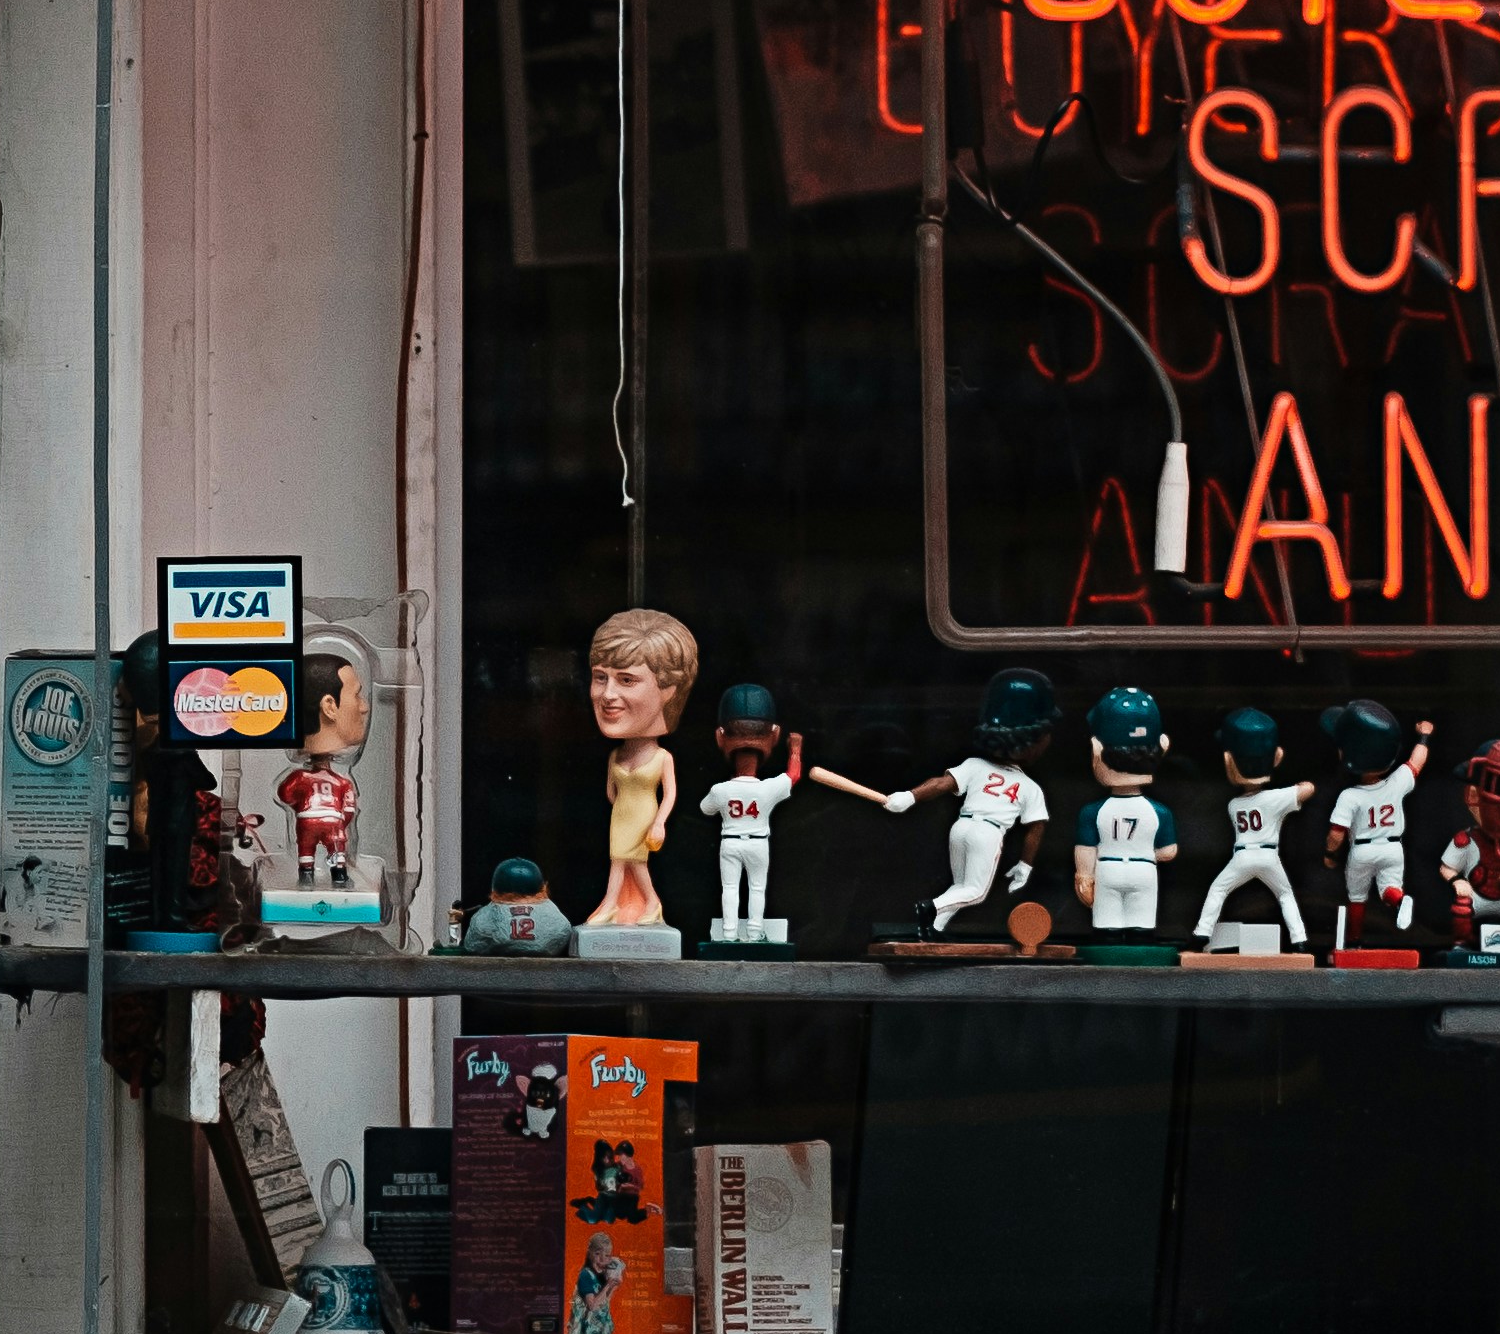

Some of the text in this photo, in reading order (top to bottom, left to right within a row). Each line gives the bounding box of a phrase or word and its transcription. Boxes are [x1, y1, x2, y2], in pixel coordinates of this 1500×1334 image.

[189, 591, 271, 618] VISA
[41, 685, 76, 716] JOE
[175, 691, 285, 714] MasterCard
[24, 708, 81, 744] LOUIS
[982, 772, 1021, 804] 24
[107, 793, 131, 851] JOE
[727, 799, 760, 819] 34
[1236, 810, 1263, 832] 50
[1367, 805, 1396, 829] 12
[1111, 817, 1138, 842] 17
[509, 918, 536, 941] 12
[1467, 954, 1497, 967] JASON
[466, 1051, 511, 1087] Furby
[590, 1054, 648, 1098] Furby
[719, 1156, 745, 1170] THE
[719, 1170, 746, 1264] BERLIN
